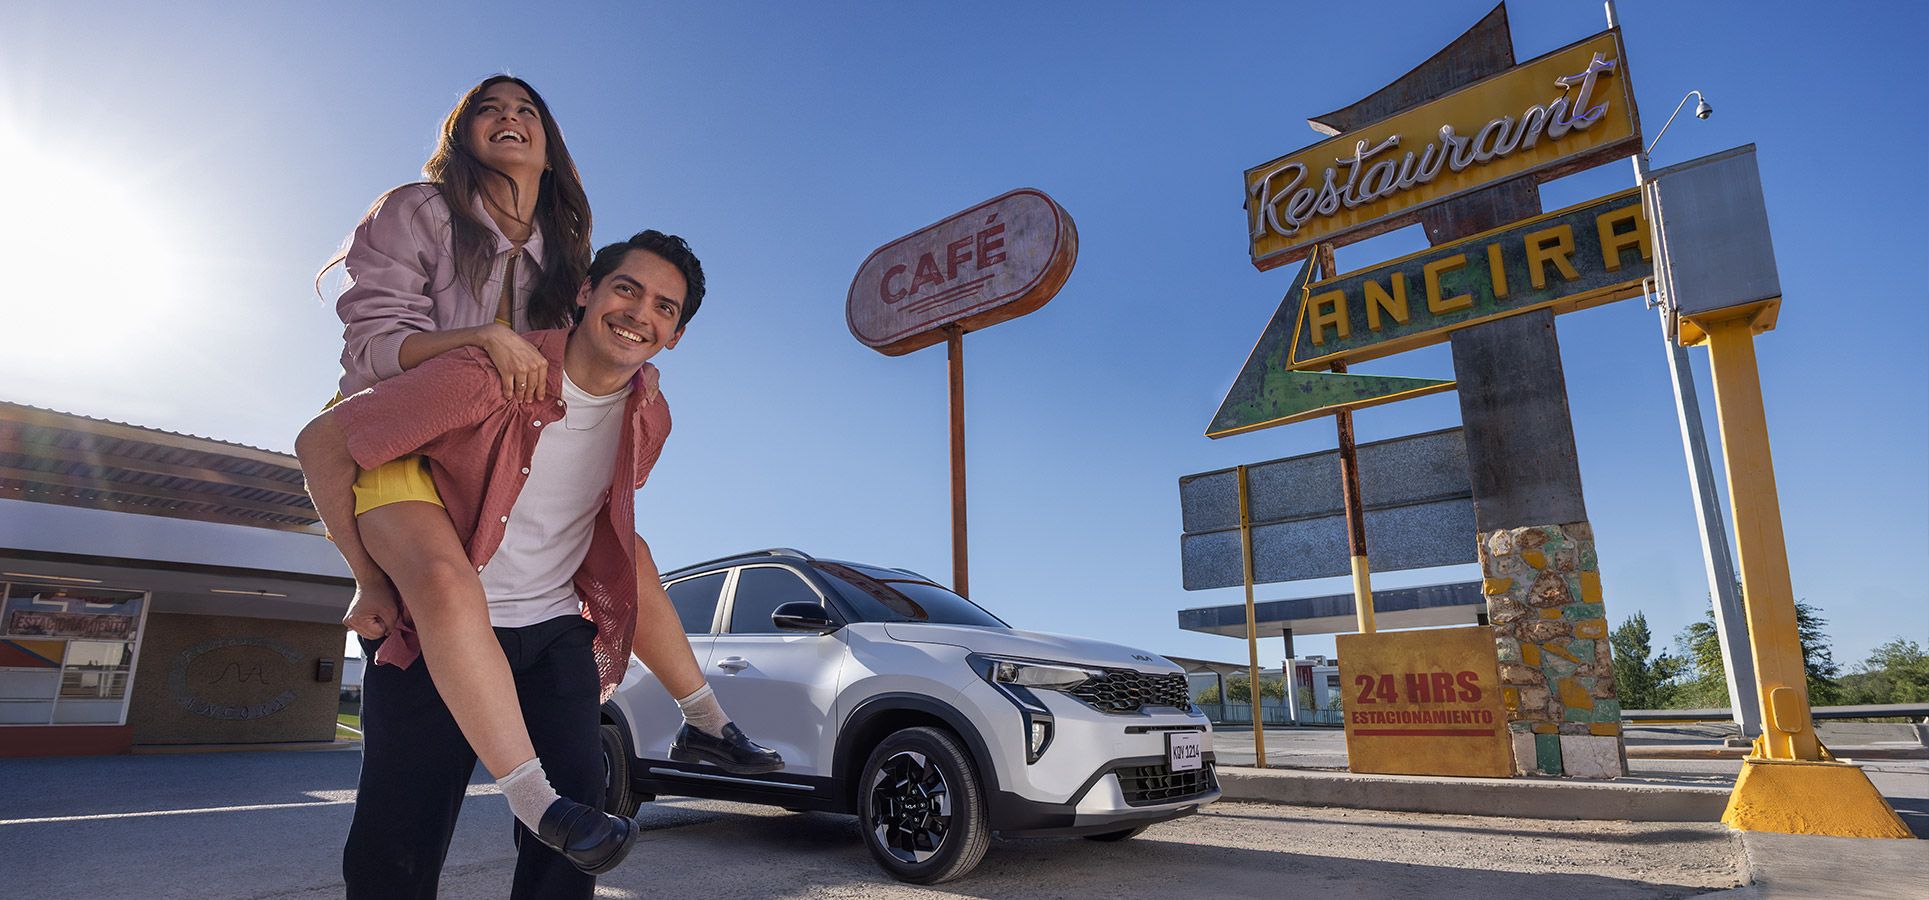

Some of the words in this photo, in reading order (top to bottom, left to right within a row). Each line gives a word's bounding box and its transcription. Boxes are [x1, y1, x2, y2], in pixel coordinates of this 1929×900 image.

[1251, 52, 1617, 240] Restaurant
[880, 213, 1006, 304] CAFÉ
[1308, 203, 1652, 346] ANCIRA
[1352, 710, 1493, 724] ESTACIONAMIENTO
[1355, 674, 1399, 704] 24
[1405, 671, 1482, 704] HRS
